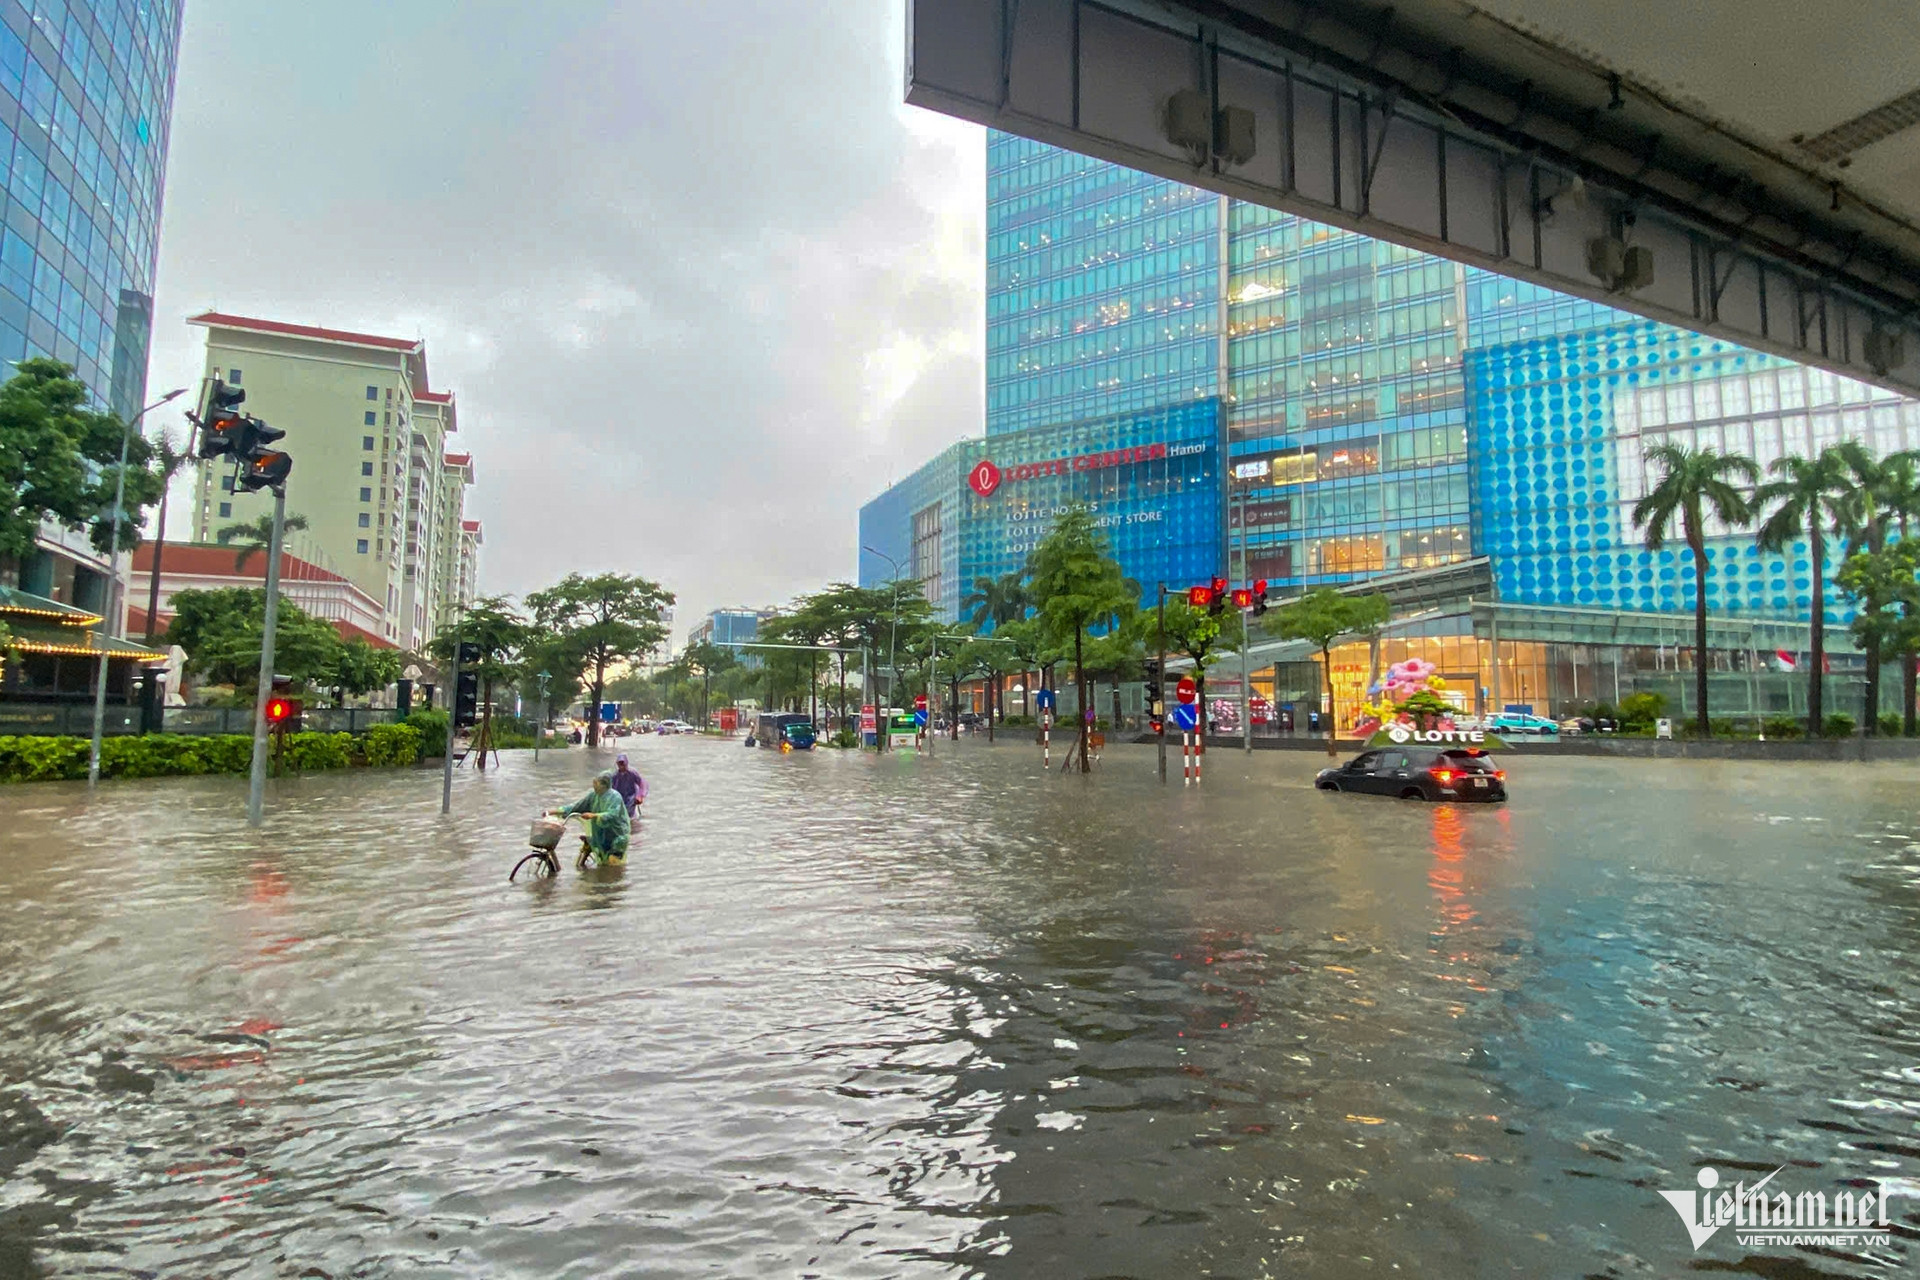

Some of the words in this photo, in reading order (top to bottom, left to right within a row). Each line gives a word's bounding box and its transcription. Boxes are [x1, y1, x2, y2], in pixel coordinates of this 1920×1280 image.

[1005, 457, 1070, 482] LOTTE
[1073, 443, 1166, 471] CENTER
[1170, 443, 1206, 457] Hanoi
[1006, 509, 1047, 521] LOTTE
[1006, 525, 1047, 537] LOTTE
[1126, 511, 1163, 524] STORE
[1414, 730, 1484, 742] LOTTE
